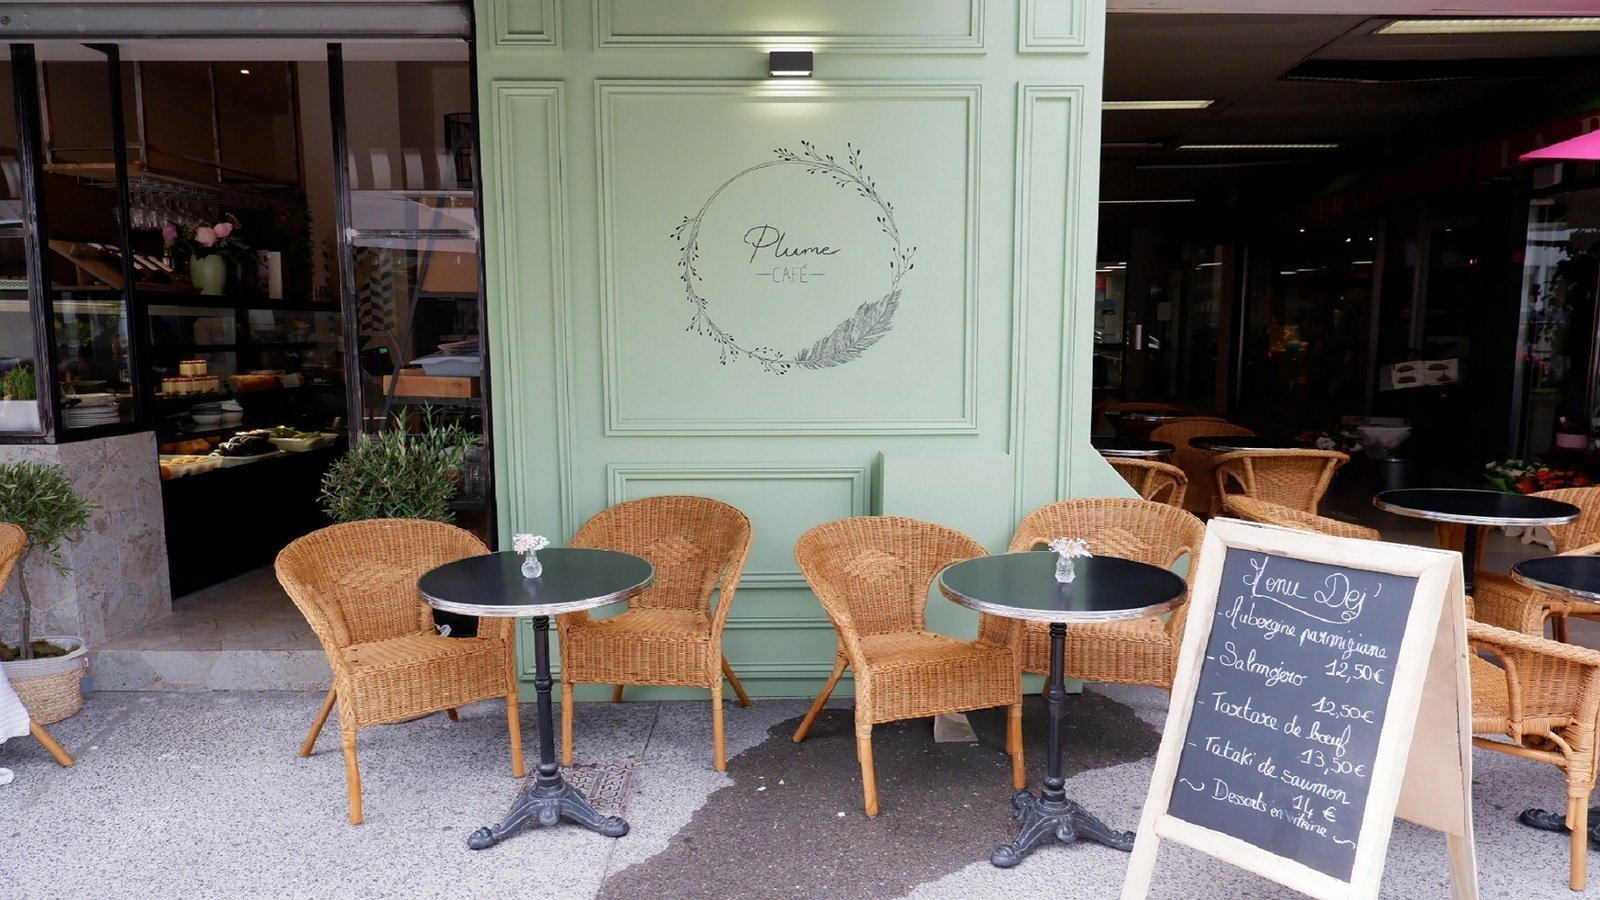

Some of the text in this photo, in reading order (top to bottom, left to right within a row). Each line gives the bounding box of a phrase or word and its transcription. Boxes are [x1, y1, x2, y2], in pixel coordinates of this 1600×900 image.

[744, 224, 841, 264] Plume
[772, 264, 808, 283] CAFÉ
[1324, 659, 1385, 684] 12,50€
[1212, 692, 1278, 730] Tartare
[1284, 715, 1302, 738] de
[1311, 696, 1375, 724] 12,50€
[1206, 736, 1351, 804] Tataki de saumon
[1301, 749, 1366, 778] 13,50€
[1211, 778, 1267, 812] Desserts
[1270, 807, 1283, 819] en
